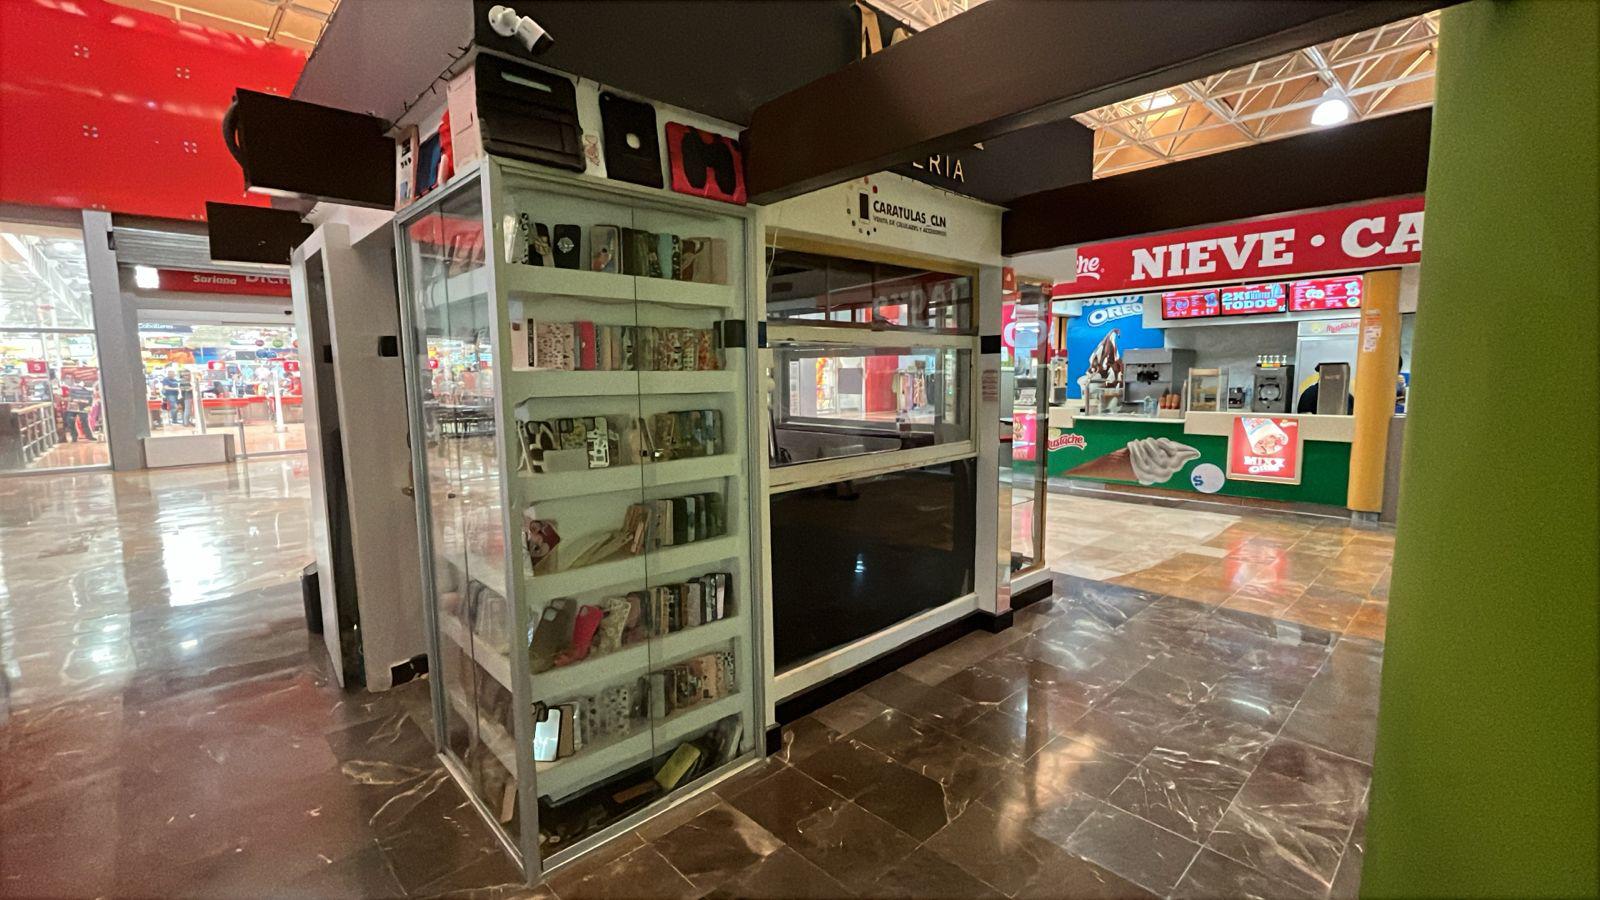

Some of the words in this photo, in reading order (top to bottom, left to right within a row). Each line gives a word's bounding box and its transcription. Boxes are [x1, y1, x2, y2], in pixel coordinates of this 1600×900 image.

[913, 154, 964, 183] RIA
[1131, 228, 1295, 281] NIEVE
[1341, 211, 1425, 258] CA
[1077, 255, 1100, 273] he
[1222, 299, 1277, 311] TODOS
